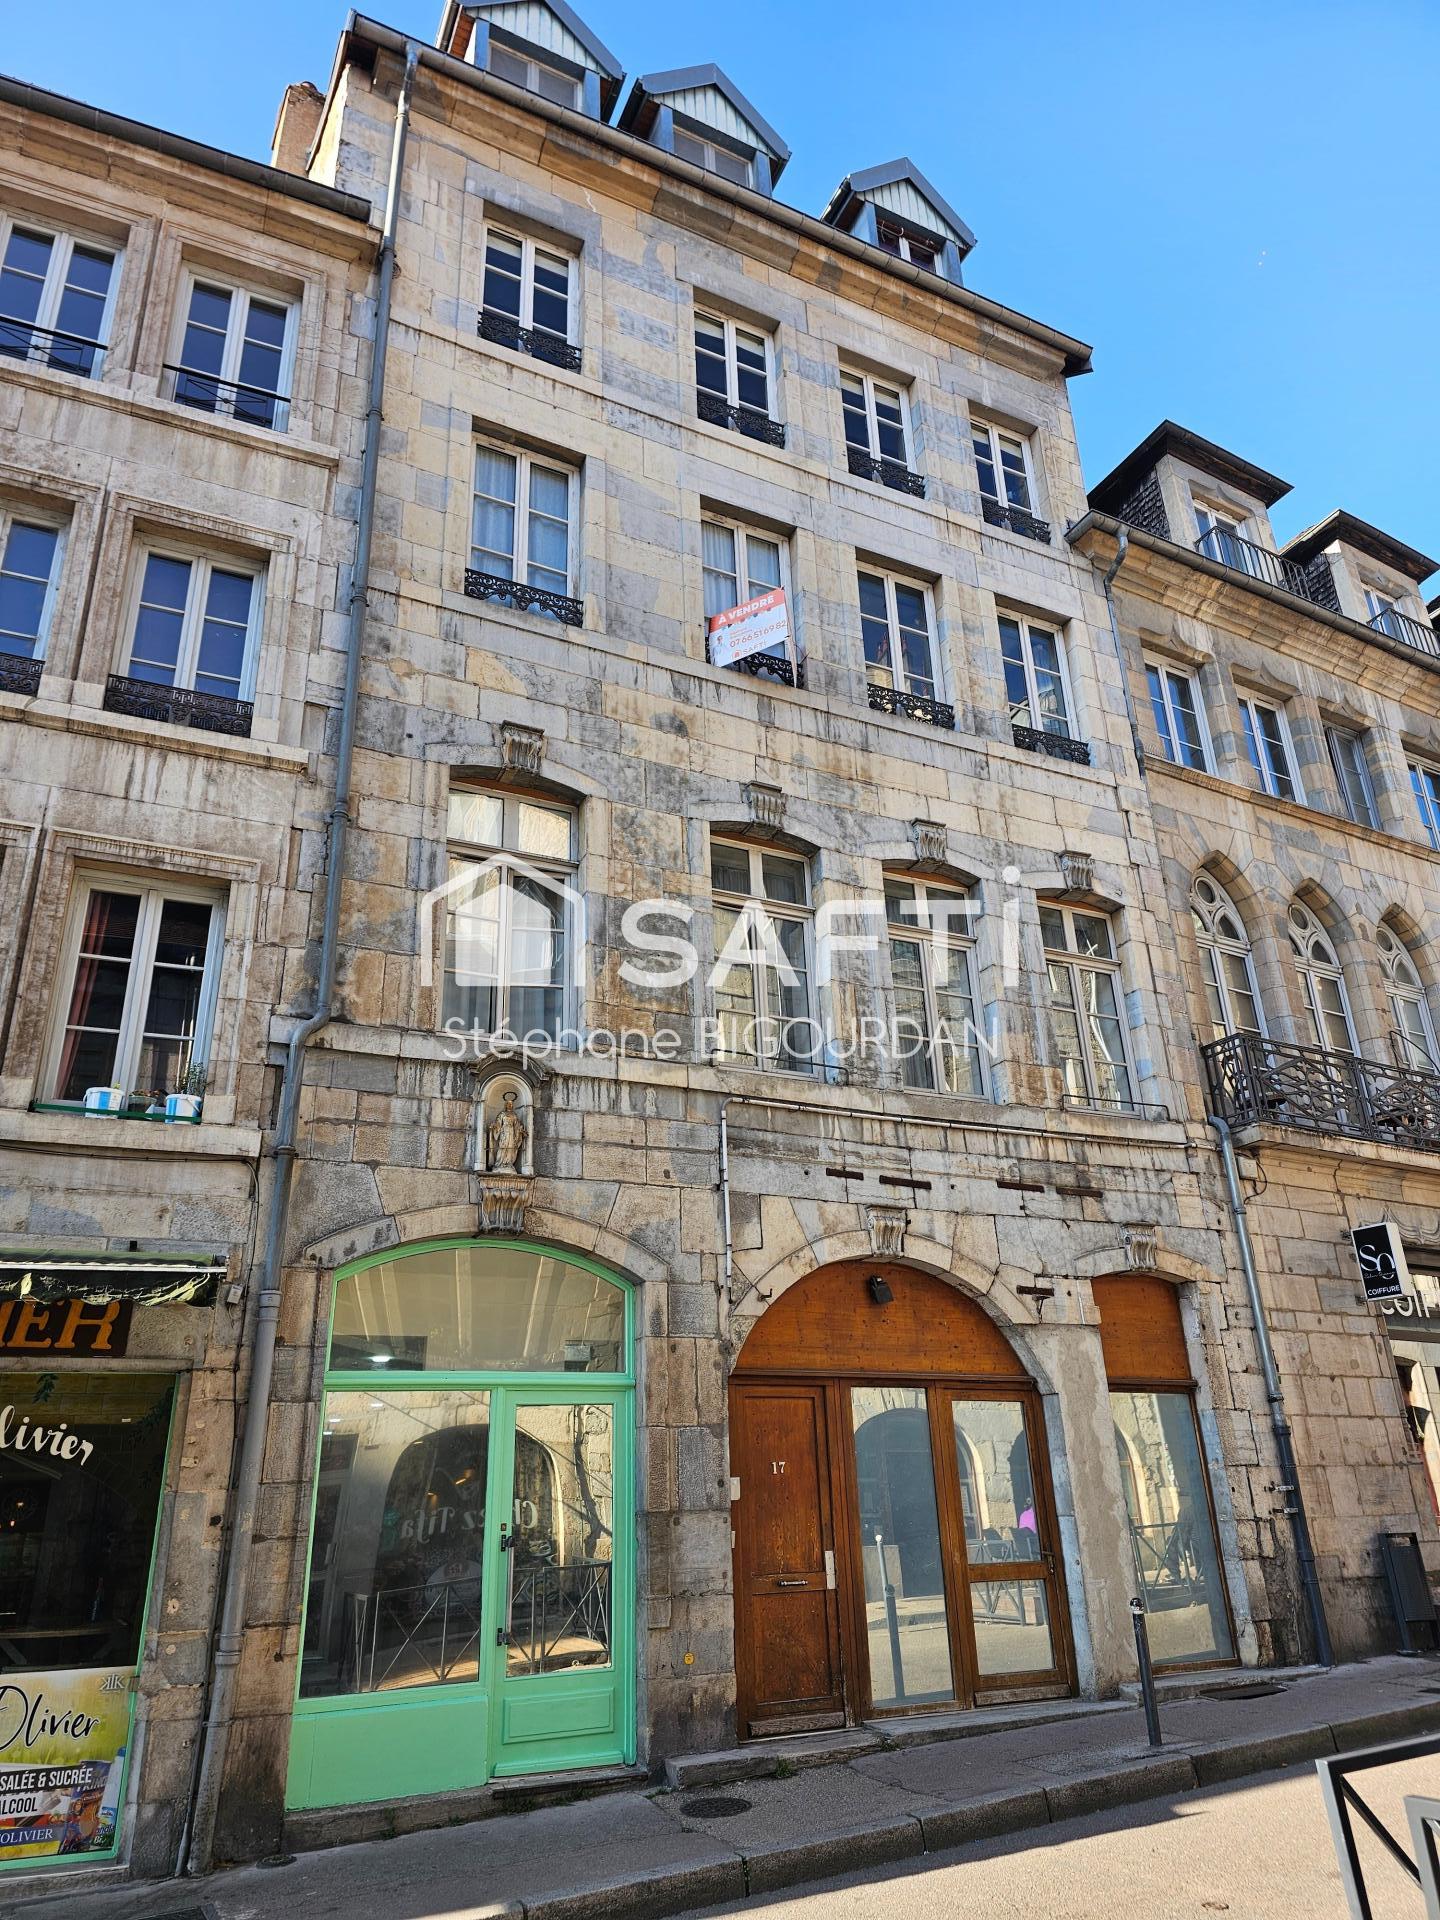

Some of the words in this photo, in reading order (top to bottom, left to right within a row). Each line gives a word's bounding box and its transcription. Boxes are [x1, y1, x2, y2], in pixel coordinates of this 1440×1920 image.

[728, 595, 774, 619] VENDRE
[1367, 1284, 1401, 1296] COIFFURE
[770, 1461, 786, 1475] 17
[0, 1770, 37, 1792] SALÉE
[37, 1772, 47, 1788] &
[48, 1765, 93, 1787] SUCRÉE
[0, 1796, 37, 1815] LCOOL
